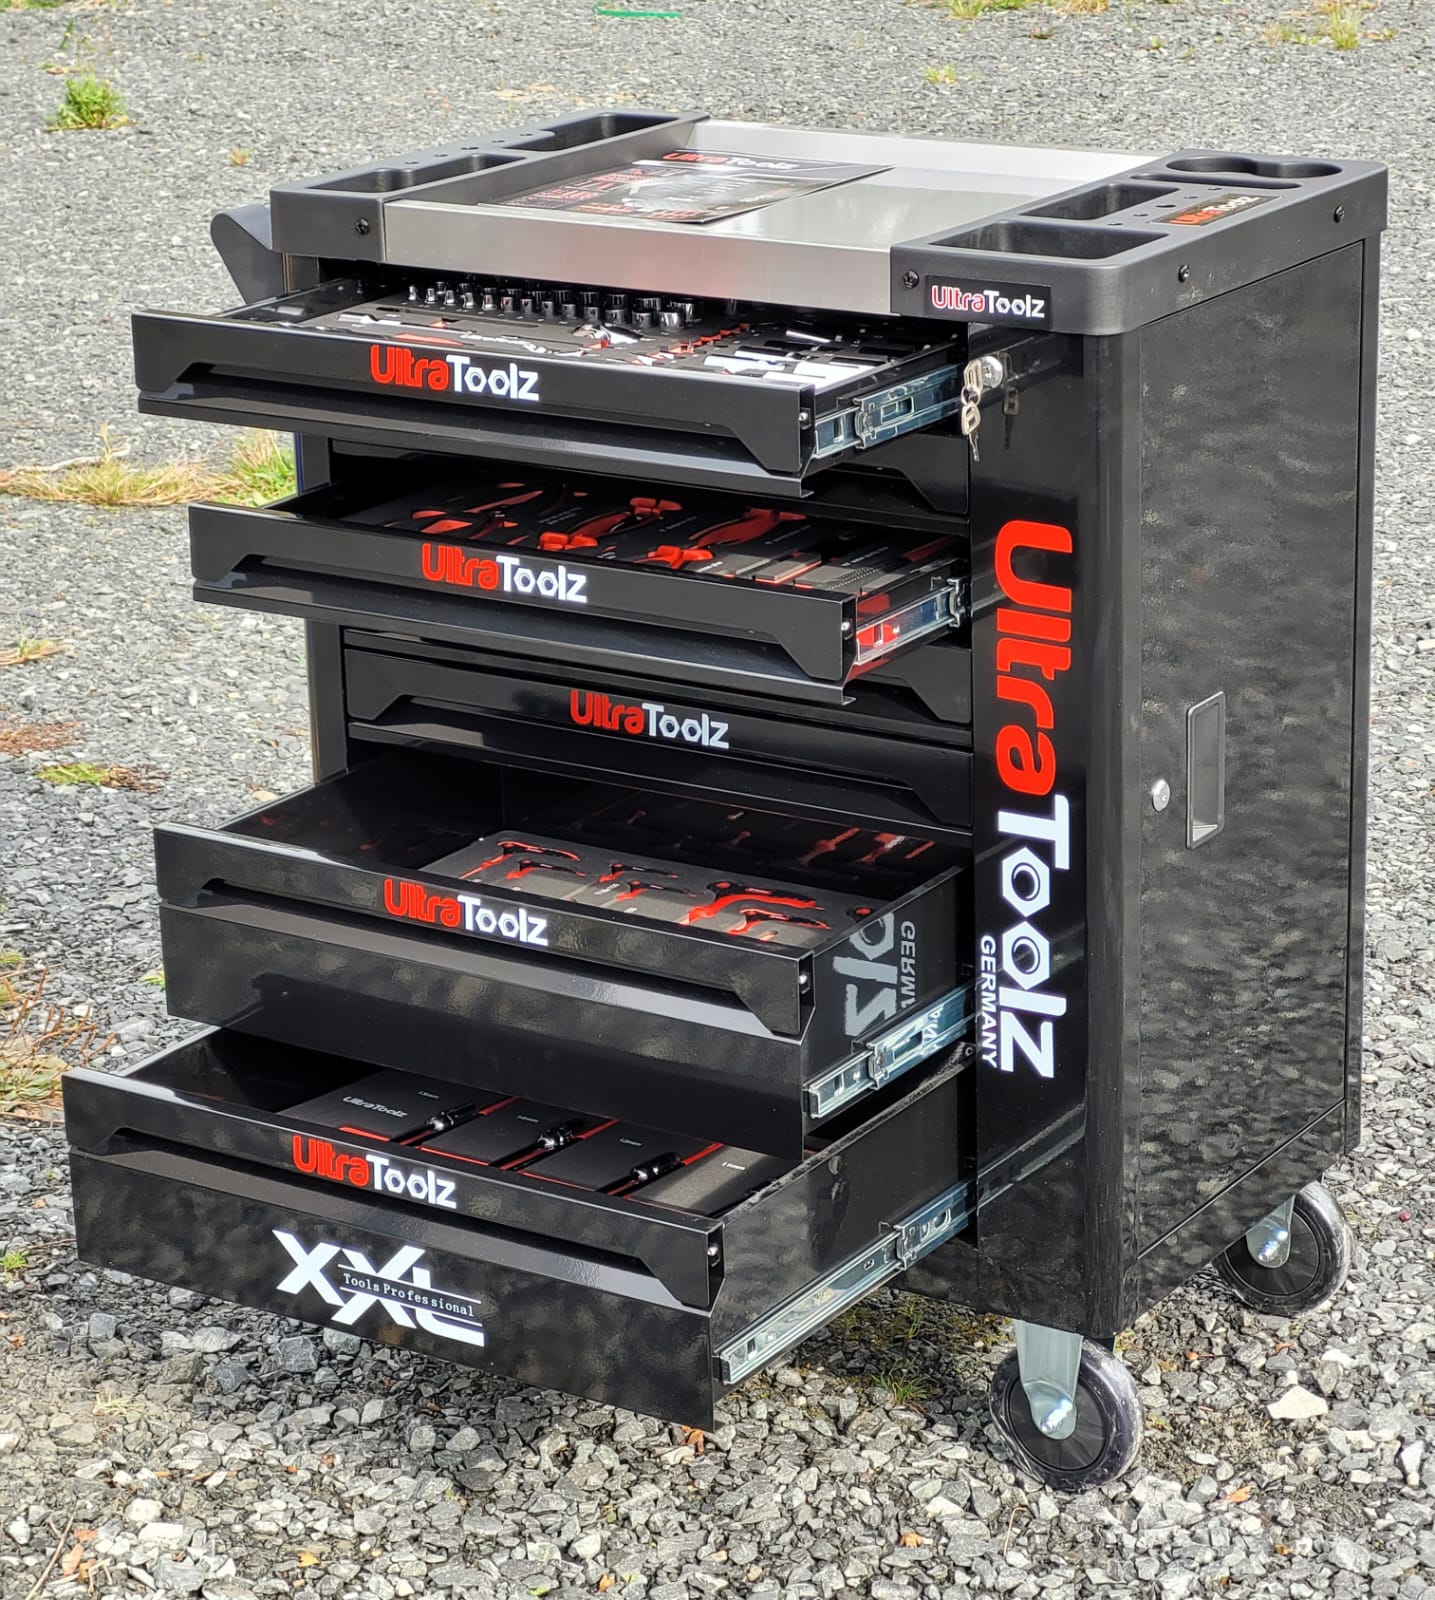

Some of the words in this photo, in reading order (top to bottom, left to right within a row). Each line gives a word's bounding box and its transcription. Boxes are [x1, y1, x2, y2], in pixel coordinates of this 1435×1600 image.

[931, 285, 1046, 319] UltraToolz
[369, 343, 541, 402] UltraToolz
[421, 542, 588, 604] UltraToolz
[569, 689, 730, 750] UltraToolz
[993, 519, 1074, 1079] UltraToolz
[383, 878, 549, 948] UltraToolz
[980, 934, 998, 1070] GERMANY
[292, 1134, 457, 1210] UltraToolz
[271, 1228, 486, 1348] XXL
[342, 1272, 381, 1293] Tools
[382, 1282, 475, 1318] Professional
